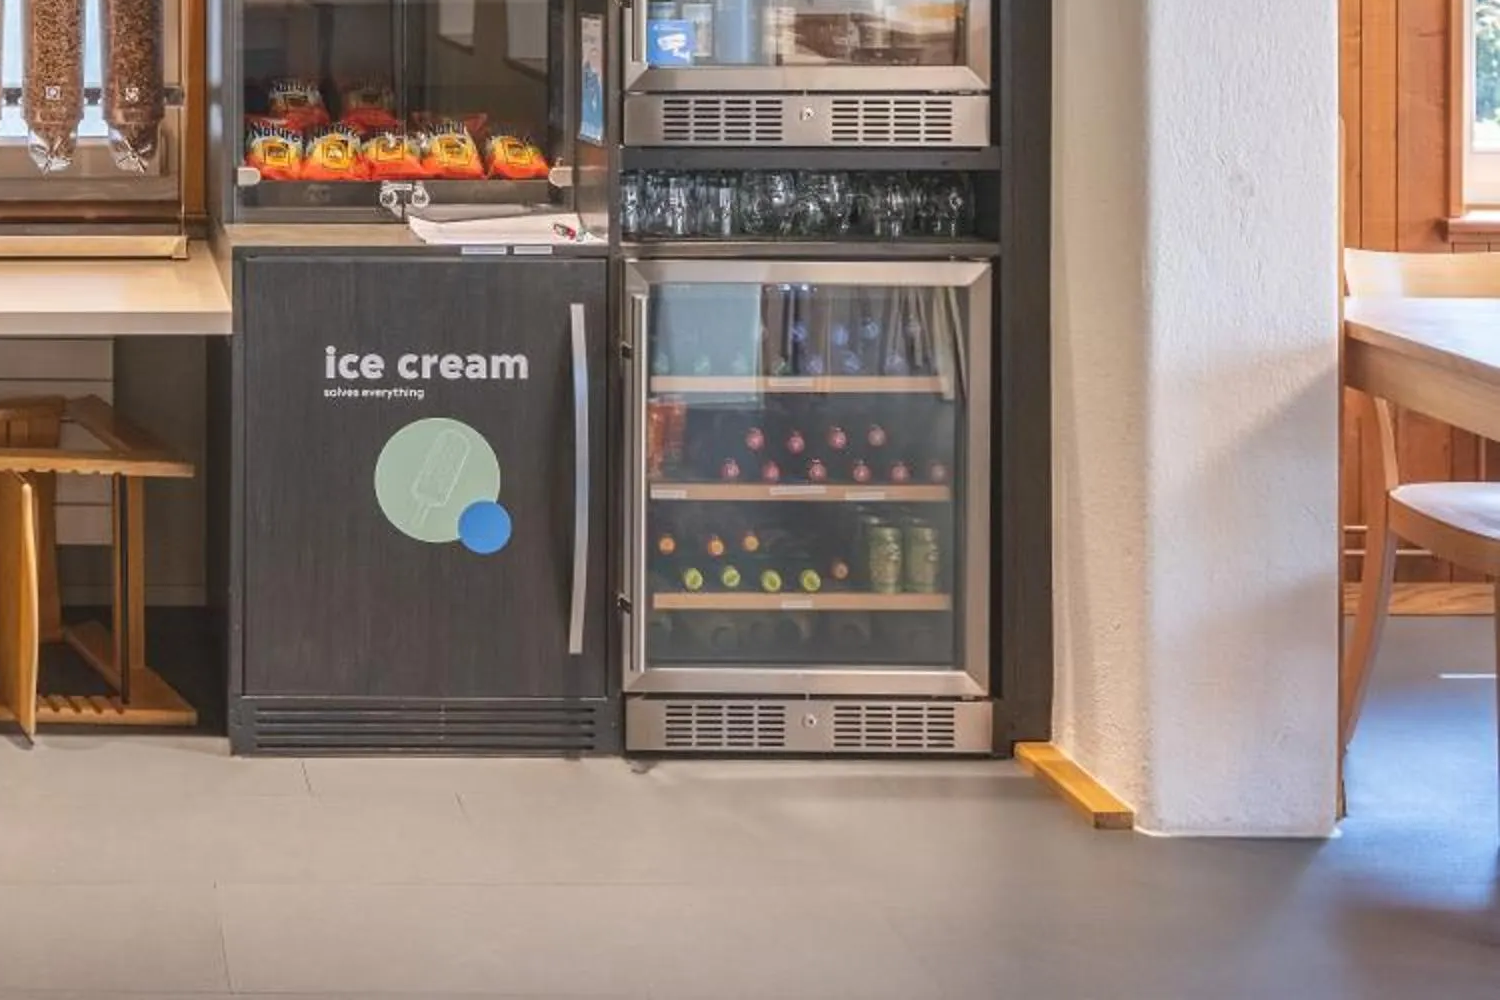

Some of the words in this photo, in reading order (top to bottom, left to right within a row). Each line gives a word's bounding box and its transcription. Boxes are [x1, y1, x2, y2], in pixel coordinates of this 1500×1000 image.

[324, 346, 385, 380] ice
[397, 353, 529, 380] cream
[323, 388, 359, 398] solves
[361, 388, 425, 400] everything
